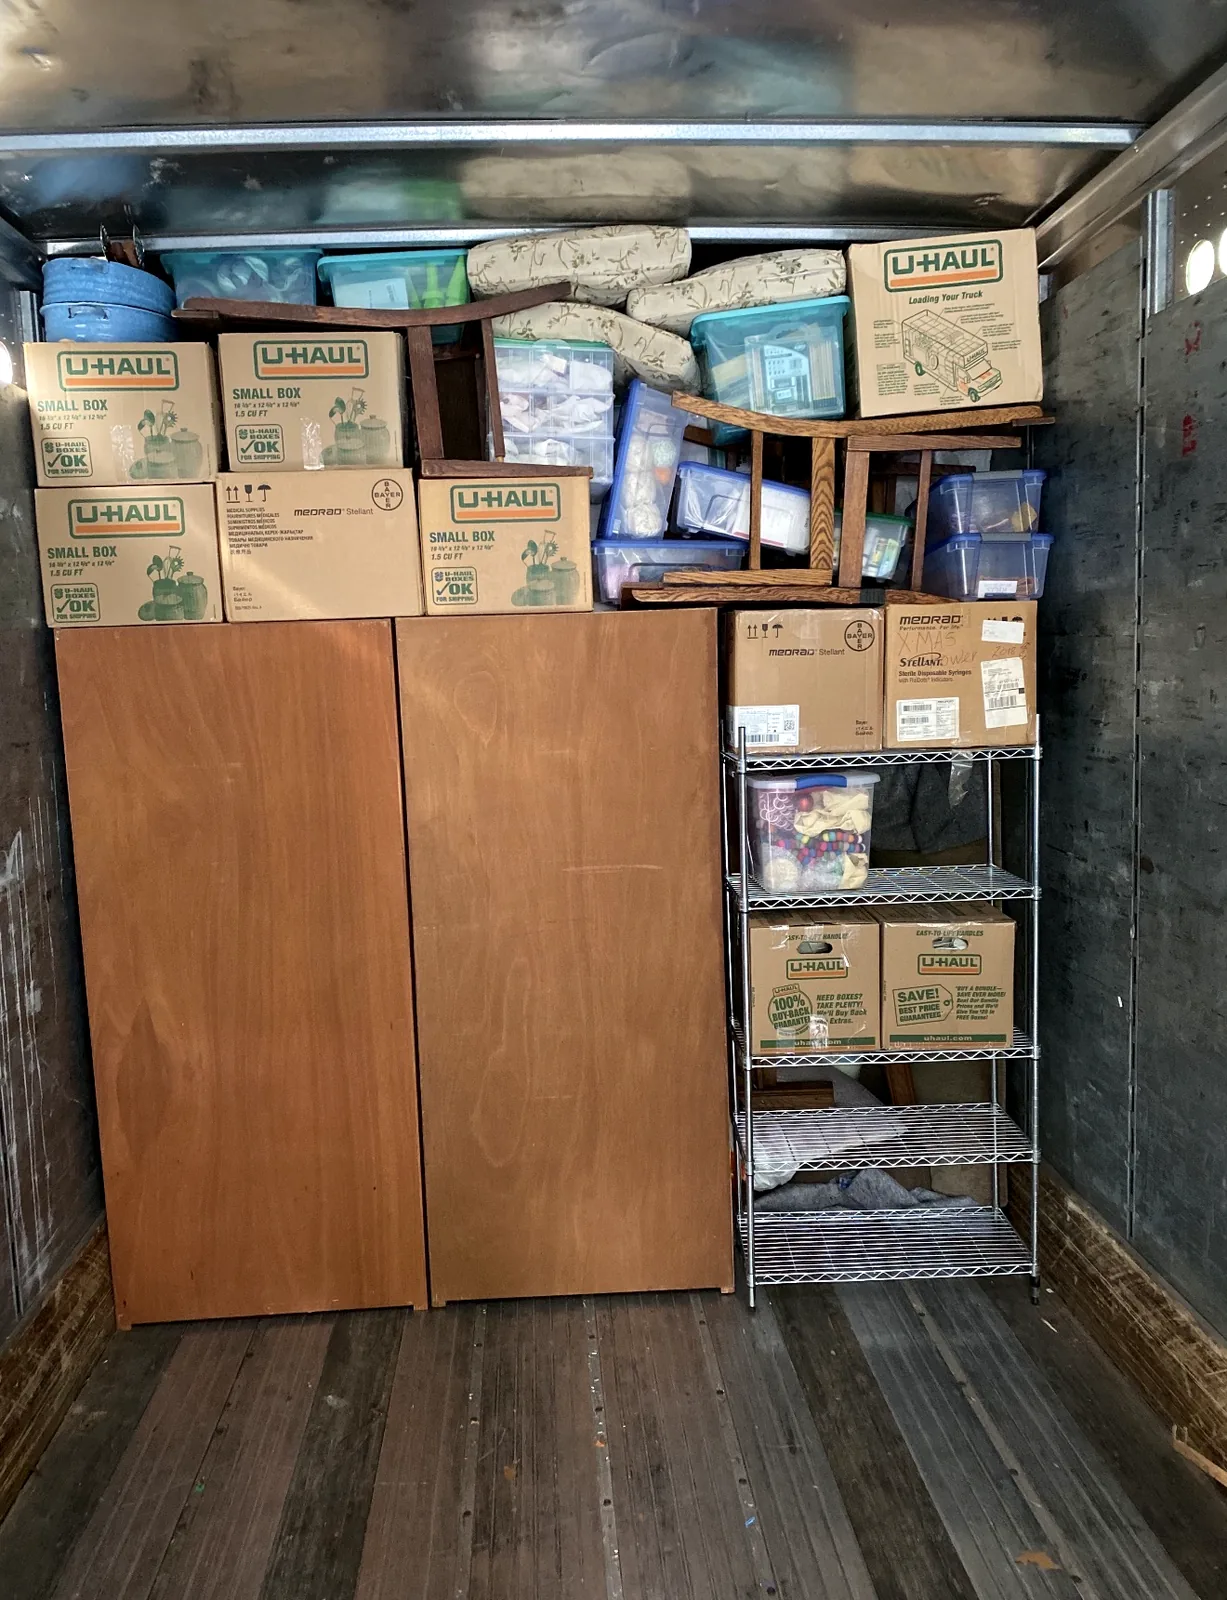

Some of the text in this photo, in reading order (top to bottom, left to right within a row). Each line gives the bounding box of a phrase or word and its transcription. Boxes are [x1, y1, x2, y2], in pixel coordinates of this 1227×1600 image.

[892, 248, 995, 275] U-HAUL
[908, 290, 983, 305] Loading Your Truck
[261, 346, 361, 365] U-HAUL
[66, 357, 171, 376] U-HAUL
[233, 387, 301, 400] SMALL BOX
[38, 399, 108, 412] SMALL BOX
[235, 410, 246, 418] 1.5
[259, 409, 268, 417] FT
[52, 422, 62, 430] CU
[64, 422, 74, 430] FT
[254, 441, 281, 453] OK
[61, 454, 88, 467] OK
[458, 490, 554, 509] U-HAUL
[76, 504, 177, 523] U-HAUL
[346, 507, 374, 516] Stellant
[429, 530, 495, 543] SMALL BOX
[47, 546, 118, 559] SMALL BOX
[431, 553, 442, 561] 1.5
[454, 552, 463, 560] FT
[74, 568, 83, 576] FT
[449, 583, 474, 595] OK
[69, 600, 96, 612] OK
[818, 648, 845, 656] Stellant
[948, 669, 972, 678] Syringes
[790, 960, 845, 972] U-HAUL
[922, 957, 978, 968] U-HAUL
[836, 993, 863, 1001] BOXES?
[897, 988, 939, 1003] SAVE!
[773, 994, 806, 1012] 100%
[898, 1003, 940, 1015] BEST PRICE
[772, 1006, 811, 1022] BUY-BACK
